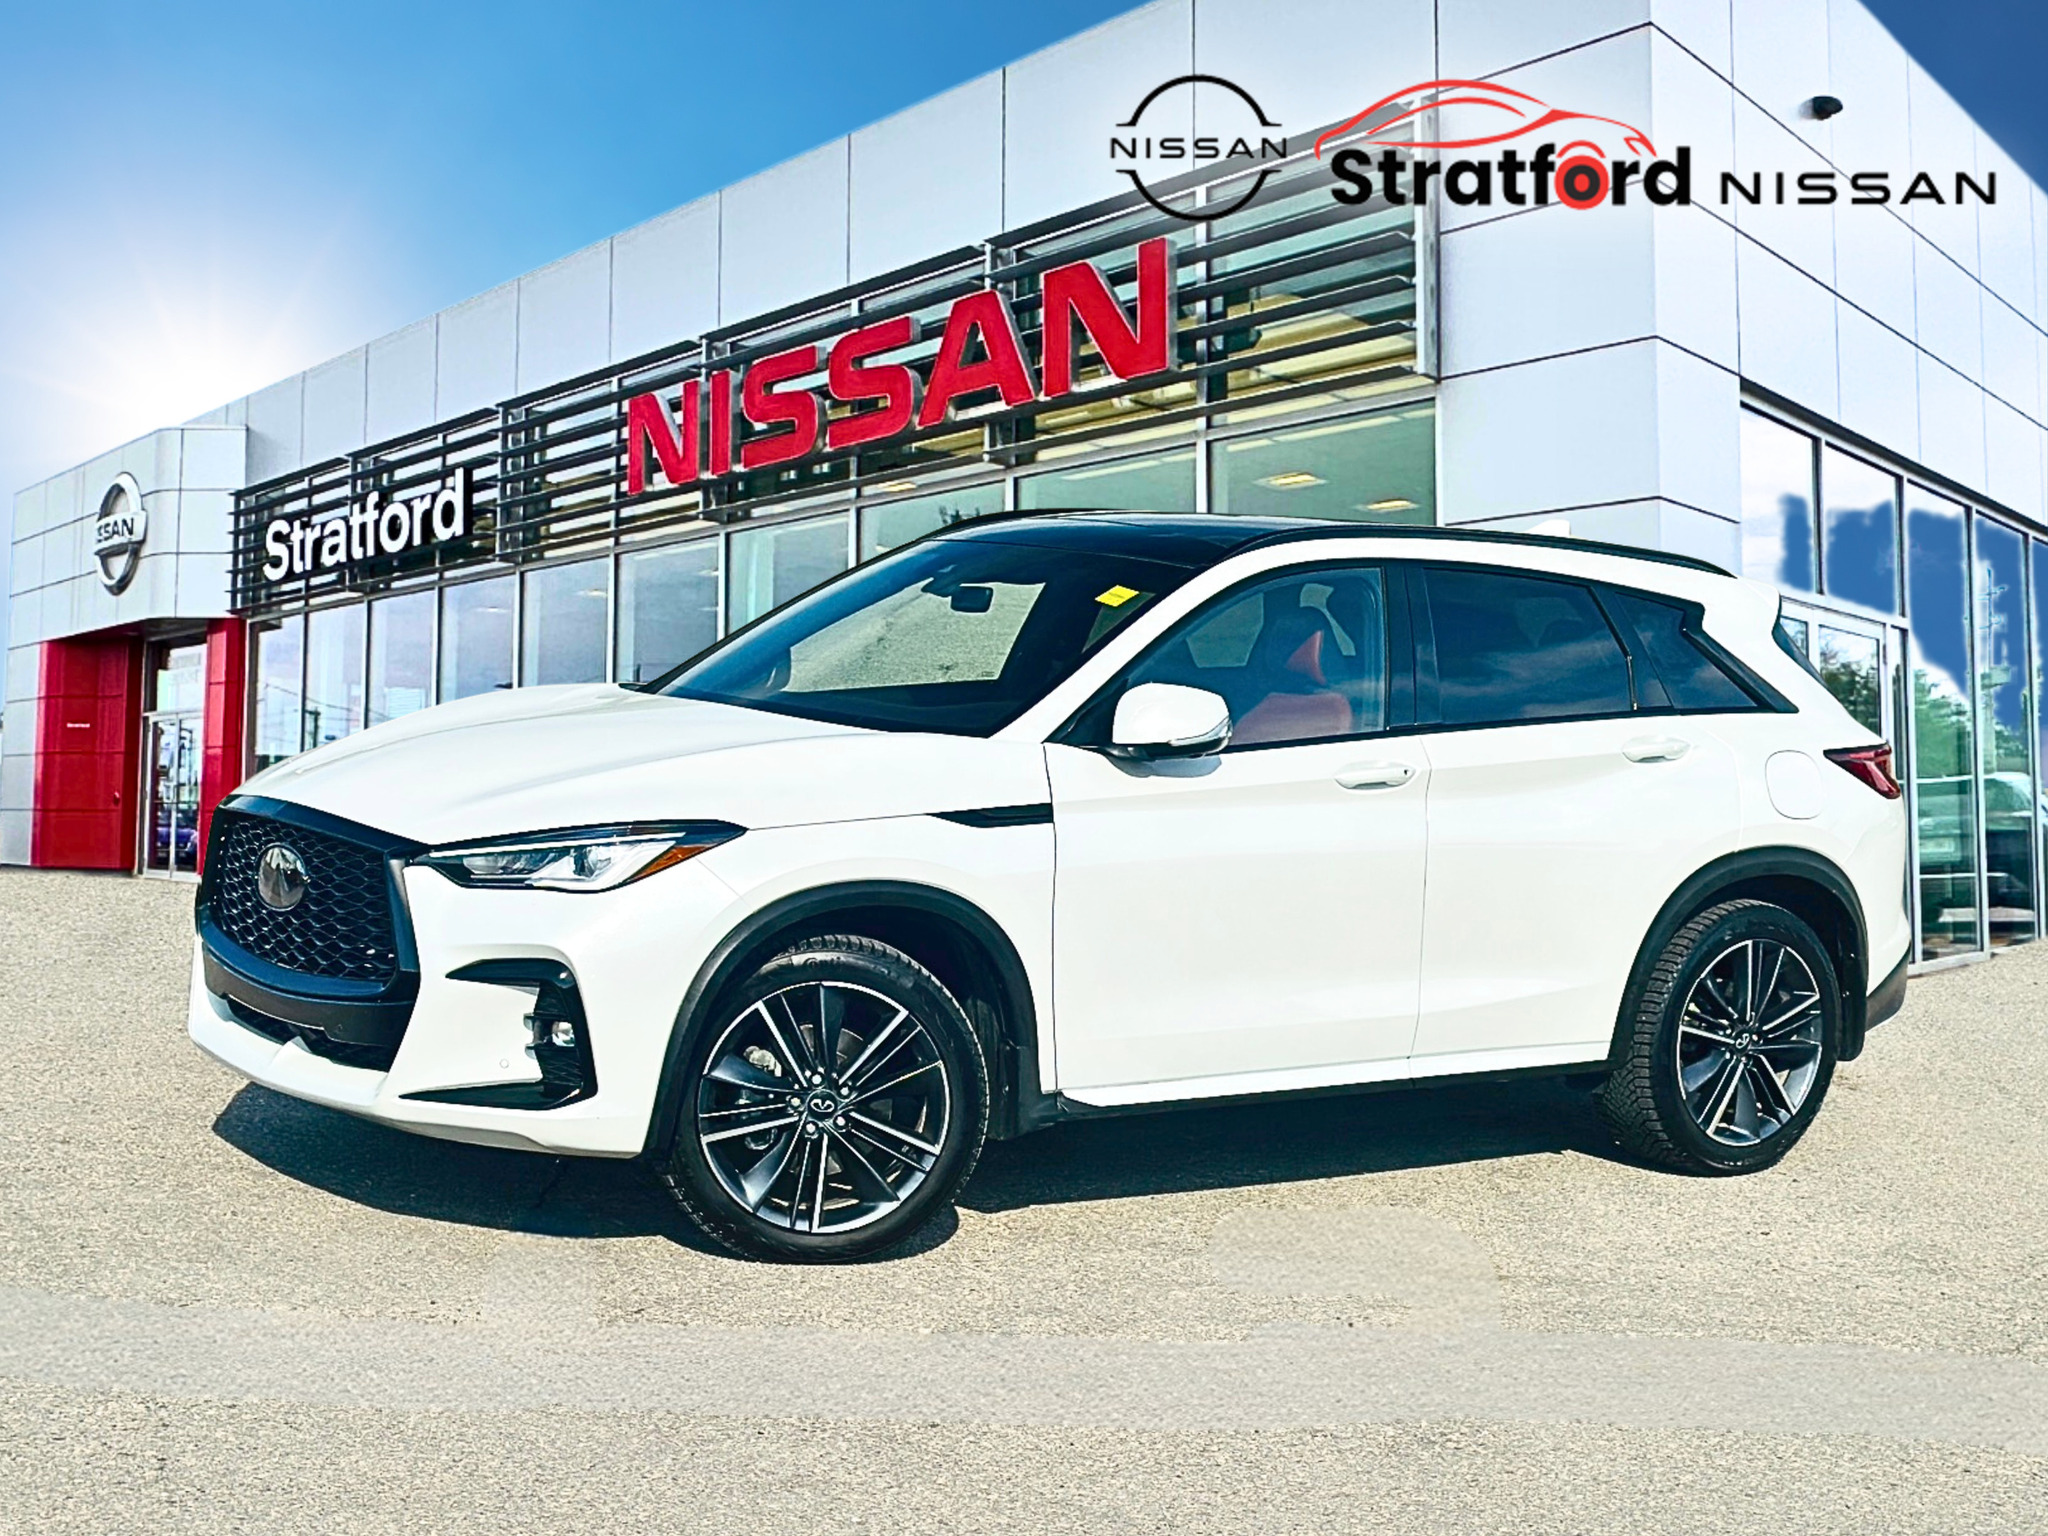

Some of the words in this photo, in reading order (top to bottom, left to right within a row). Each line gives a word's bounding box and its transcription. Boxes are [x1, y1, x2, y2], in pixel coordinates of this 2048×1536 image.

[627, 237, 1170, 496] NISSAN
[96, 516, 135, 544] SSAN
[262, 467, 465, 581] Stratford
